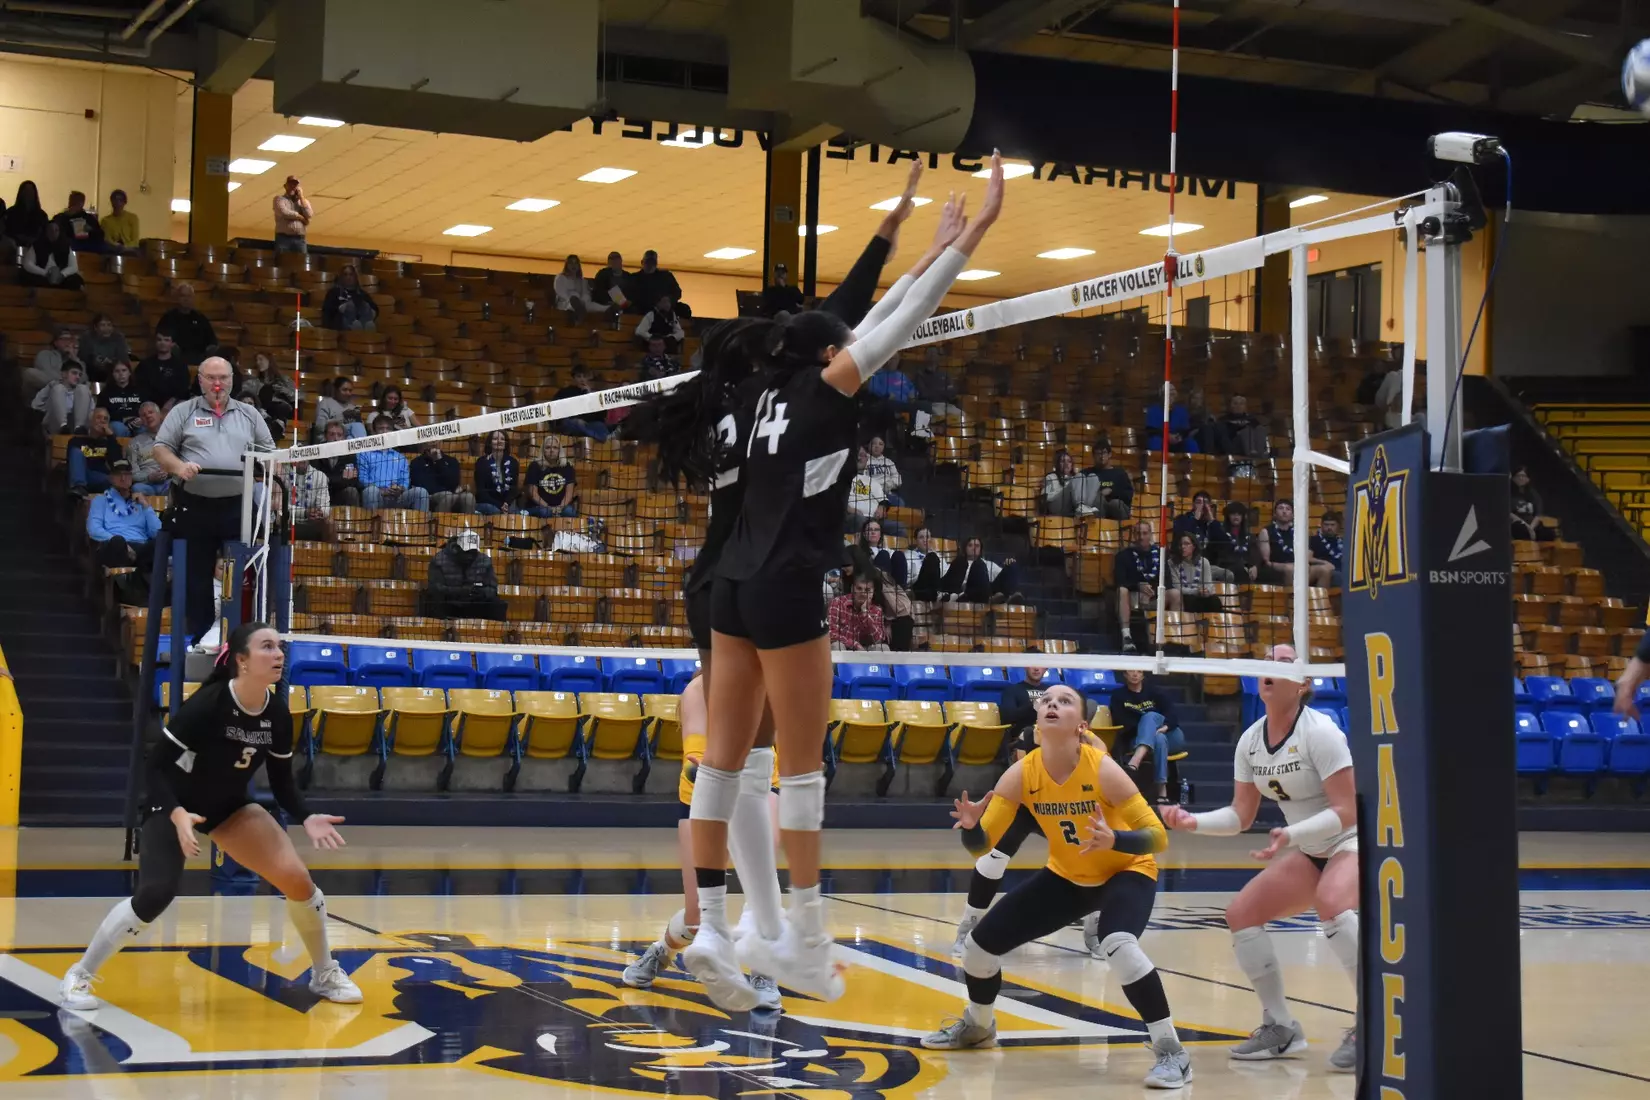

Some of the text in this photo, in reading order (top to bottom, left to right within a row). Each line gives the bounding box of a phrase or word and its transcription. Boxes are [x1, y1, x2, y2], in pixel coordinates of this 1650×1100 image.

[1082, 278, 1118, 302] RACER
[747, 388, 790, 459] 14
[1429, 571, 1505, 585] BSN SPORTS
[234, 747, 257, 768] 3
[1277, 761, 1301, 775] STATE
[1033, 802, 1069, 816] MURRAY
[1059, 820, 1080, 845] 2
[1364, 632, 1407, 1100] RACE
